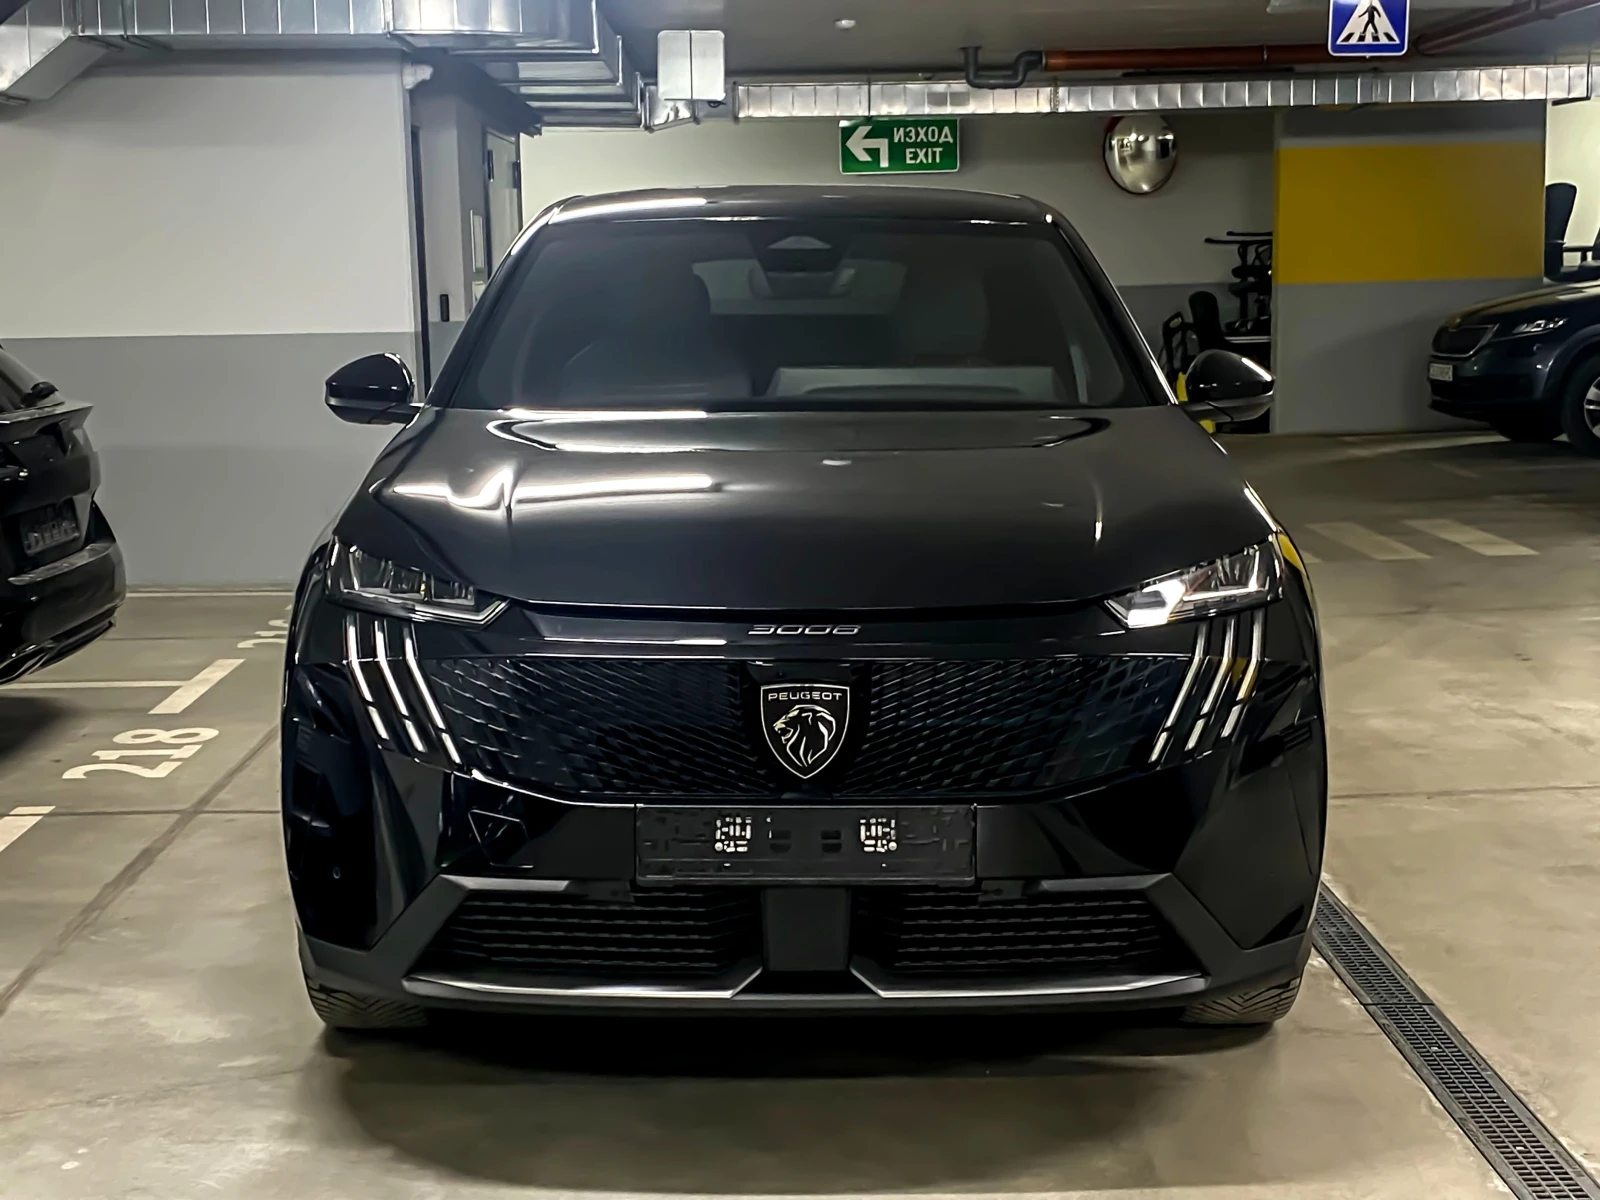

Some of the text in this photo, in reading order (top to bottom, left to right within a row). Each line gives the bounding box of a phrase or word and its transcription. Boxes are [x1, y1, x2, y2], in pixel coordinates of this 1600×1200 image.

[893, 126, 954, 144] ИЗХОД
[905, 147, 943, 164] EXIT
[748, 624, 861, 635] 3008
[767, 691, 843, 701] PEUGEOT
[61, 727, 220, 779] 218
